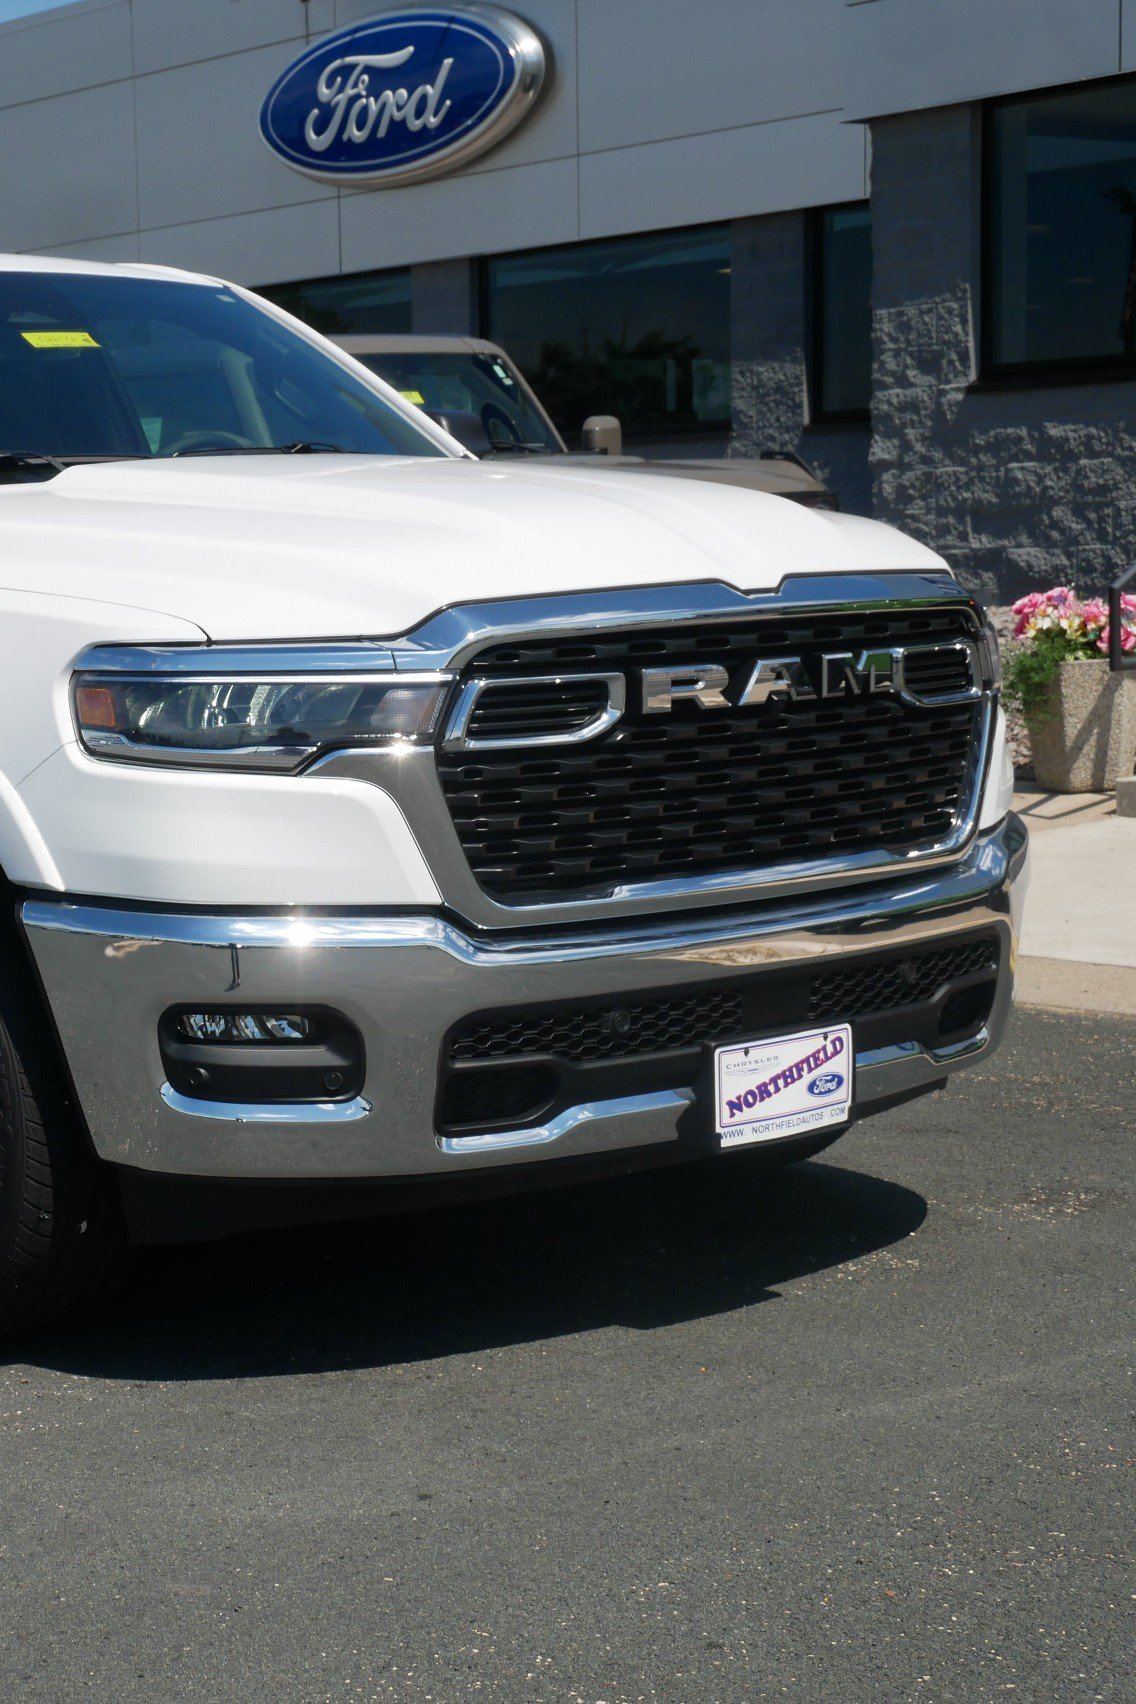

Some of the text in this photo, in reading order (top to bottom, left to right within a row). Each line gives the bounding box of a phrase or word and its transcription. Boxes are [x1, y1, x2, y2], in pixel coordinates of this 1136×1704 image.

[305, 46, 454, 151] Ford
[642, 649, 902, 714] RAM
[725, 1036, 844, 1118] NORTHFIELD
[726, 1055, 779, 1069] CHRYSLER
[751, 1111, 824, 1134] NORTHFIELDAUTOS
